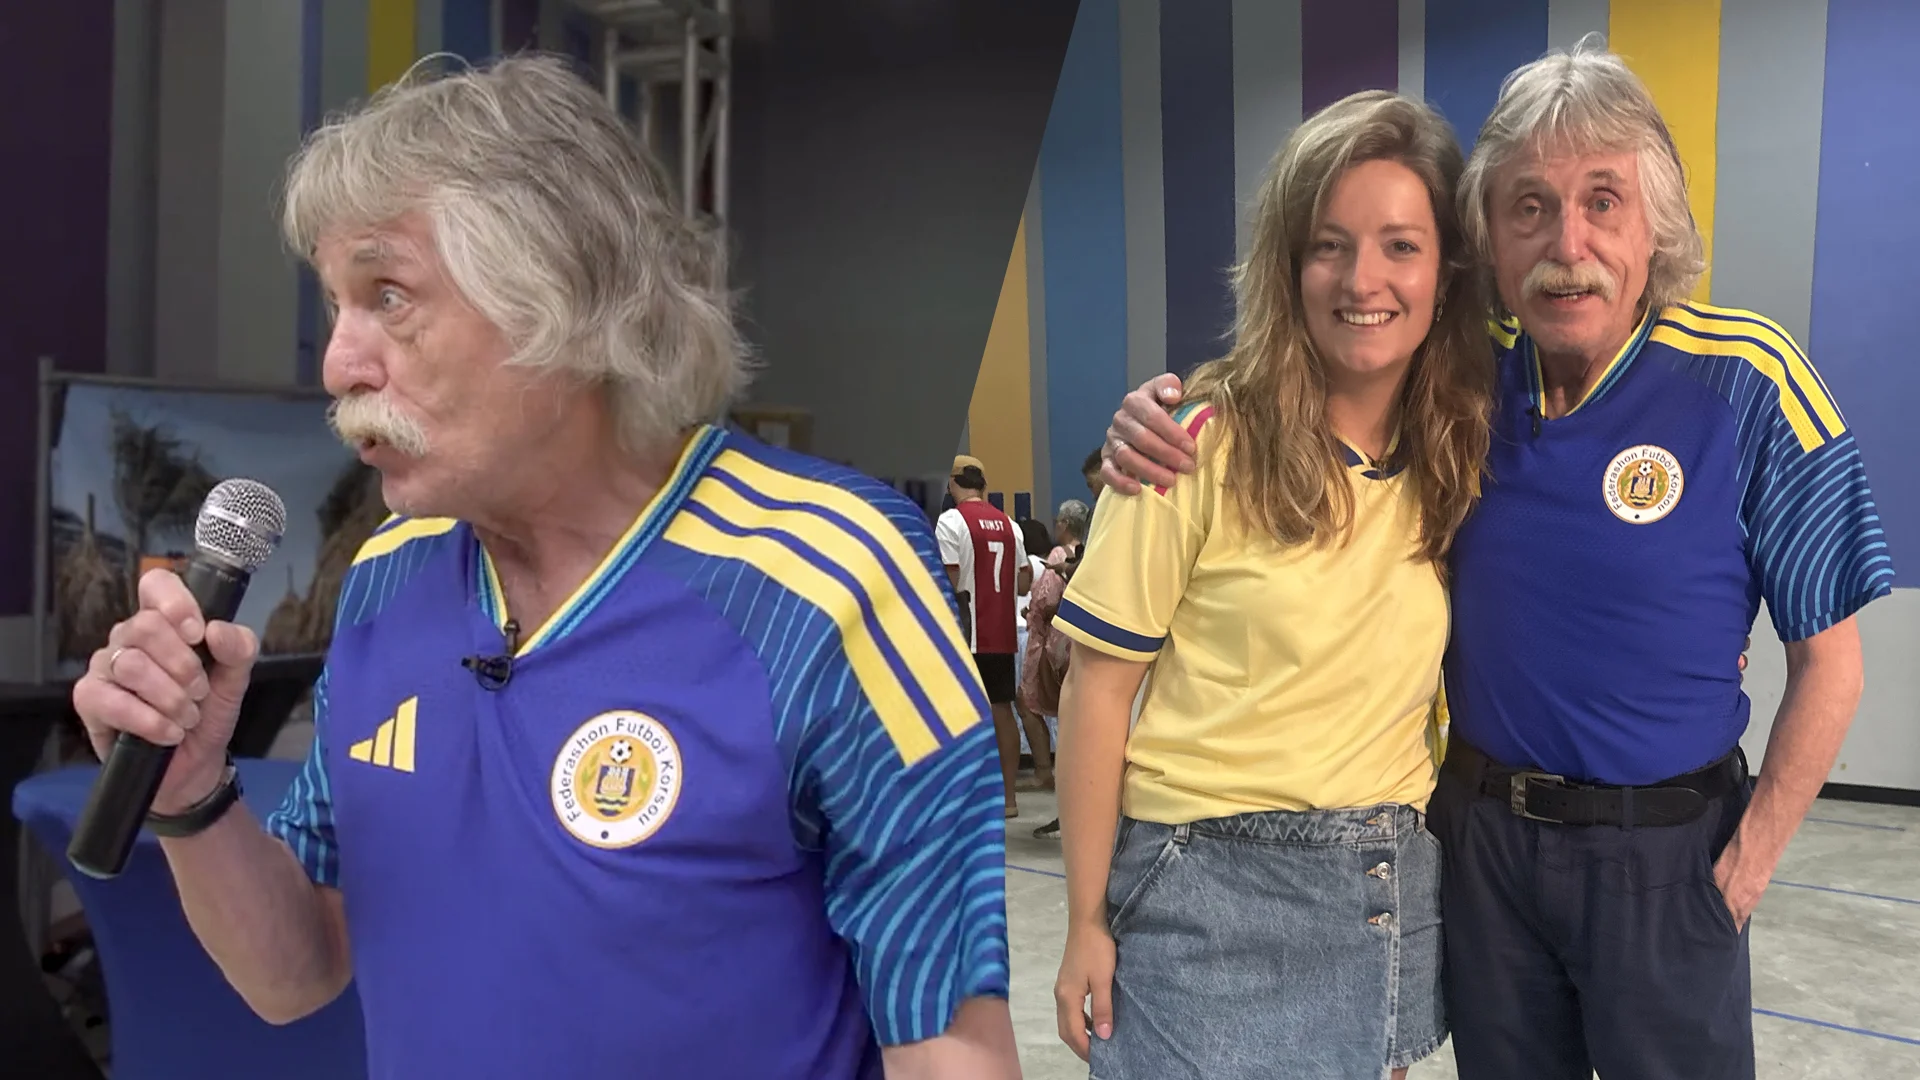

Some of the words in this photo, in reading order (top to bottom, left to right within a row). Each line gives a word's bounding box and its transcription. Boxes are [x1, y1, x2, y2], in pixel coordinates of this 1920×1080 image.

[1607, 452, 1638, 510] Federashon
[978, 519, 1005, 532] KUNST
[987, 541, 1005, 593] 7
[558, 725, 608, 823] Federashon
